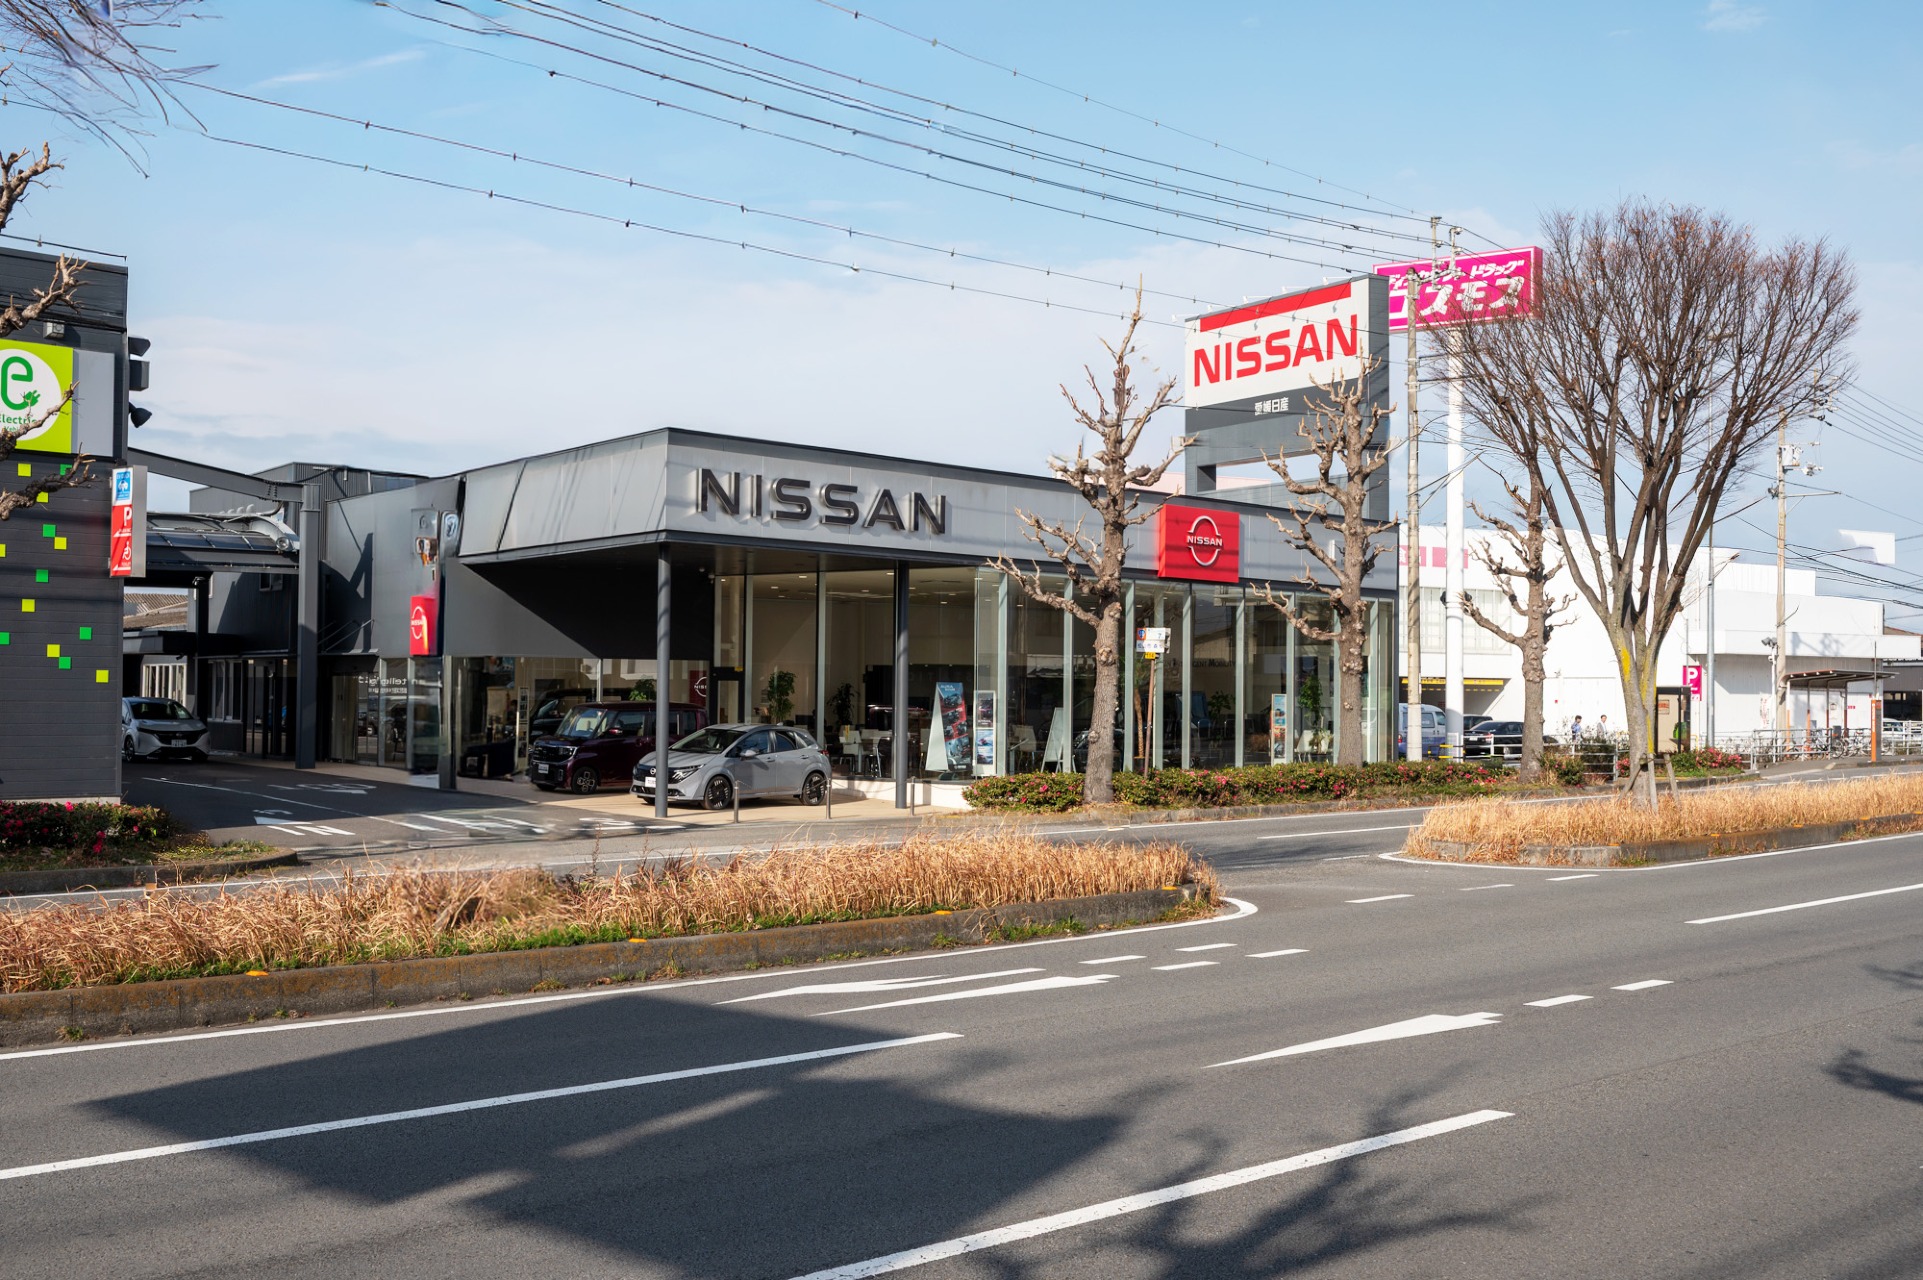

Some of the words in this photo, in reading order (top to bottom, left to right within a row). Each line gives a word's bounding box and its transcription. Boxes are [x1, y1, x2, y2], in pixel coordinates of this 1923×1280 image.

[1470, 260, 1525, 278] ドラッグ
[1389, 276, 1524, 321] コスモス
[1194, 314, 1358, 387] NISSAN
[697, 468, 947, 534] NISSAN
[124, 507, 132, 526] P
[1187, 535, 1223, 546] NISSAN
[1687, 668, 1698, 685] P
